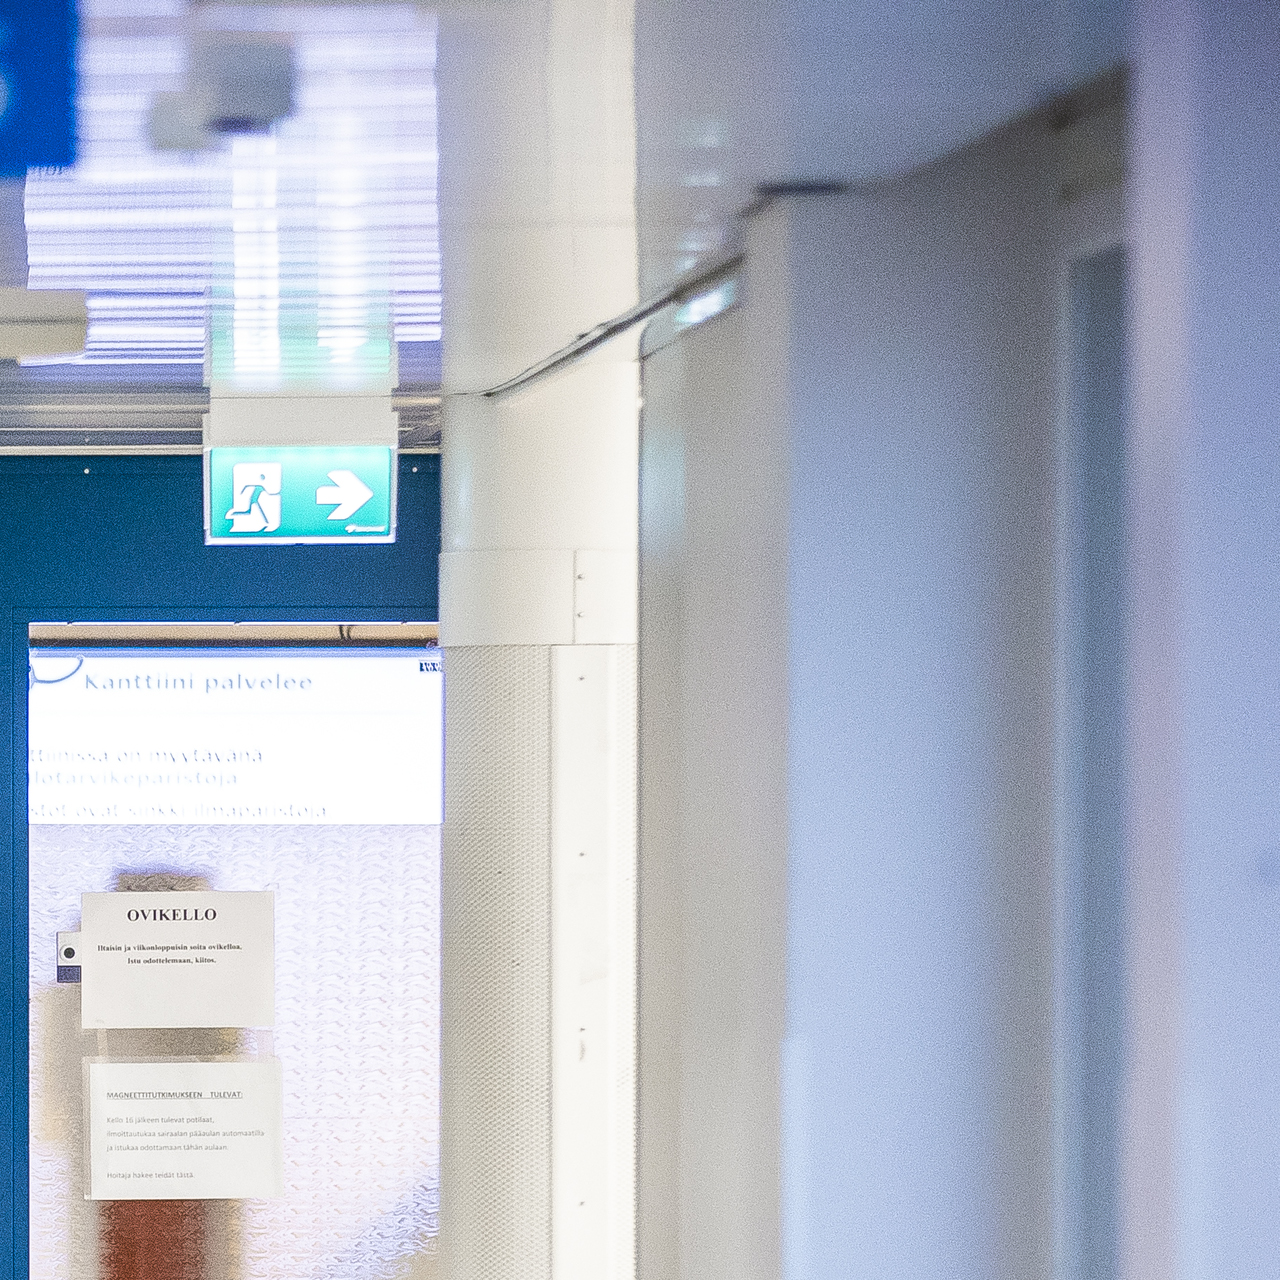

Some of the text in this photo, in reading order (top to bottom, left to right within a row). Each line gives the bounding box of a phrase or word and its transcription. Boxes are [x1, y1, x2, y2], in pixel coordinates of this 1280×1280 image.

[85, 673, 312, 694] Kanttiini palvelee
[30, 770, 238, 789] lotarvikeparistoja
[127, 908, 217, 922] OVIKELLO
[124, 944, 131, 953] ja
[133, 944, 188, 952] viikonloppuisin
